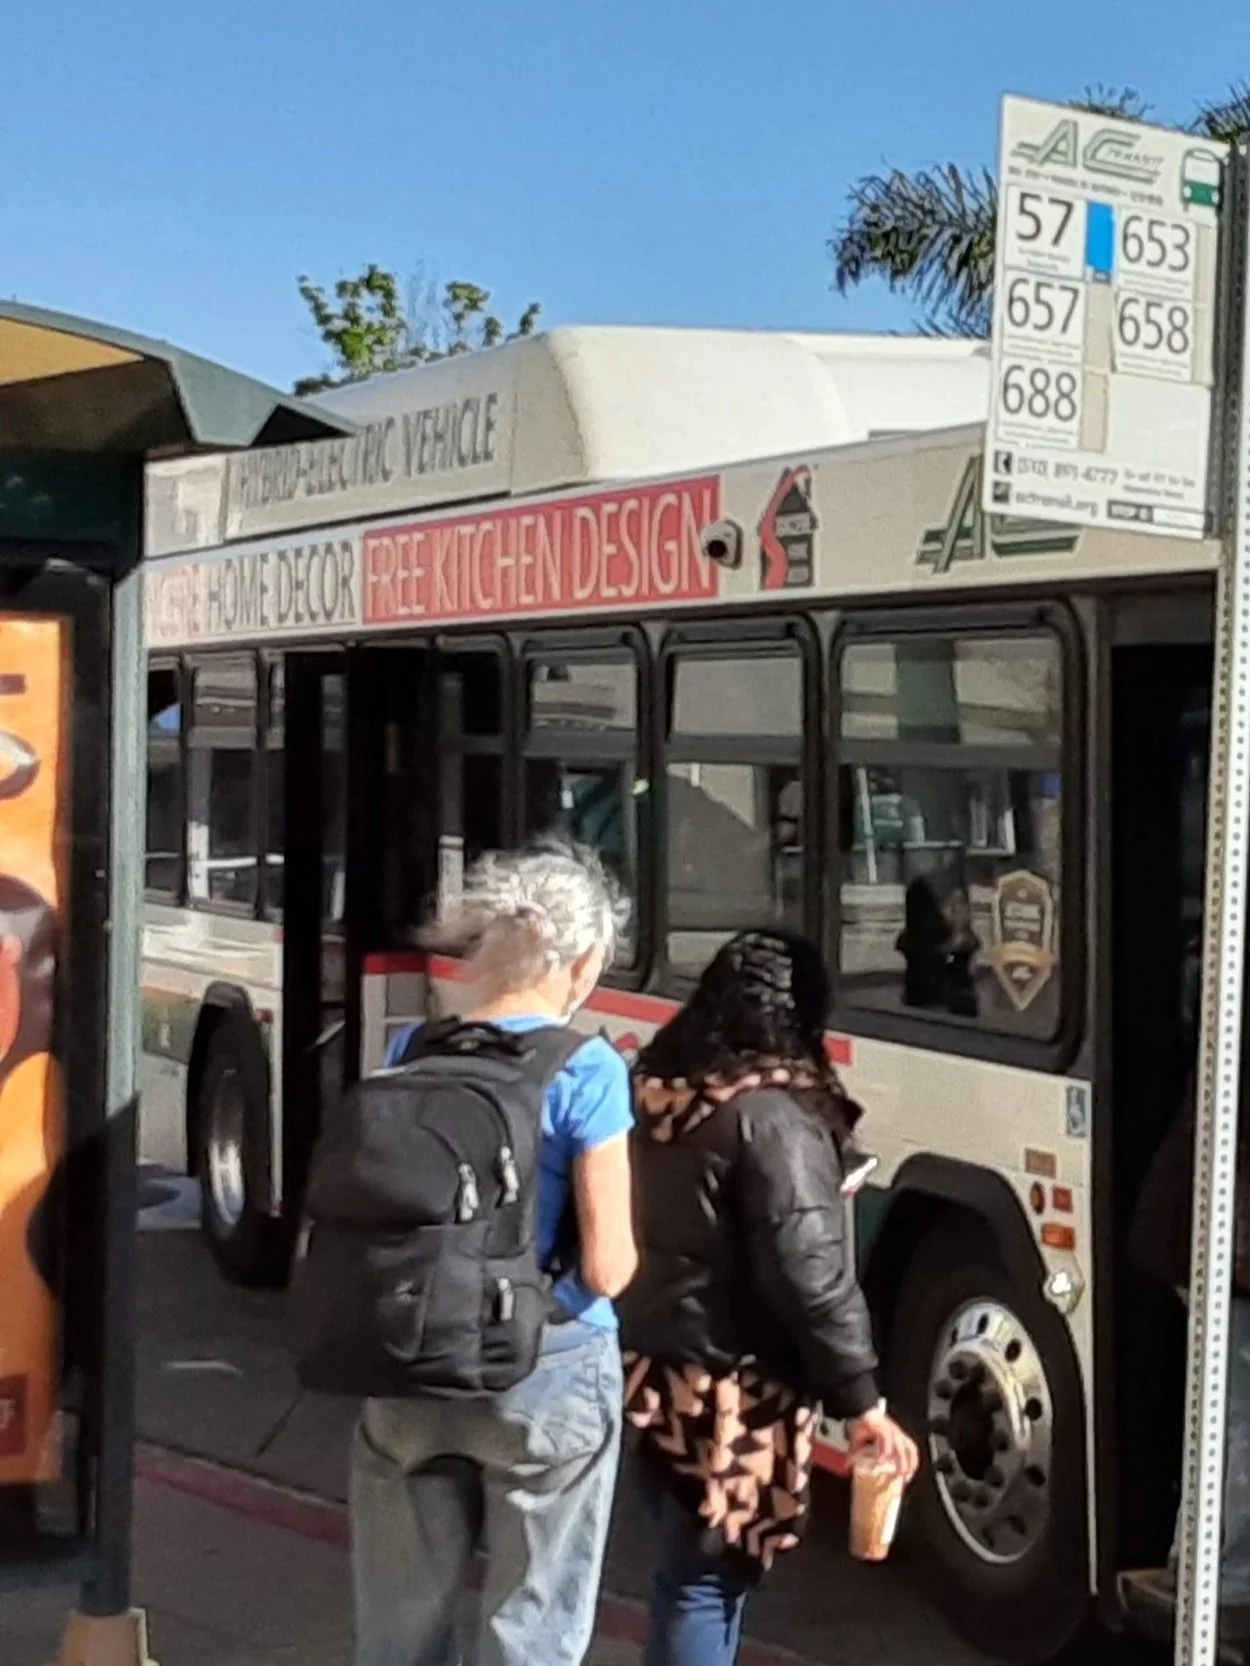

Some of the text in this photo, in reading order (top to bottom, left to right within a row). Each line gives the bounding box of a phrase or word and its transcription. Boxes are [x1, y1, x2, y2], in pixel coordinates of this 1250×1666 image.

[1016, 191, 1074, 247] 57
[1122, 214, 1191, 273] 653
[1008, 277, 1080, 335] 657
[1118, 297, 1190, 355] 658
[1002, 364, 1078, 422] 688
[403, 392, 498, 478] VEHICLE
[207, 553, 269, 633] HOME
[276, 541, 356, 625] DECOR
[365, 531, 426, 619] FREE
[434, 510, 562, 614] KITCHEN
[573, 488, 712, 601] DESIGN
